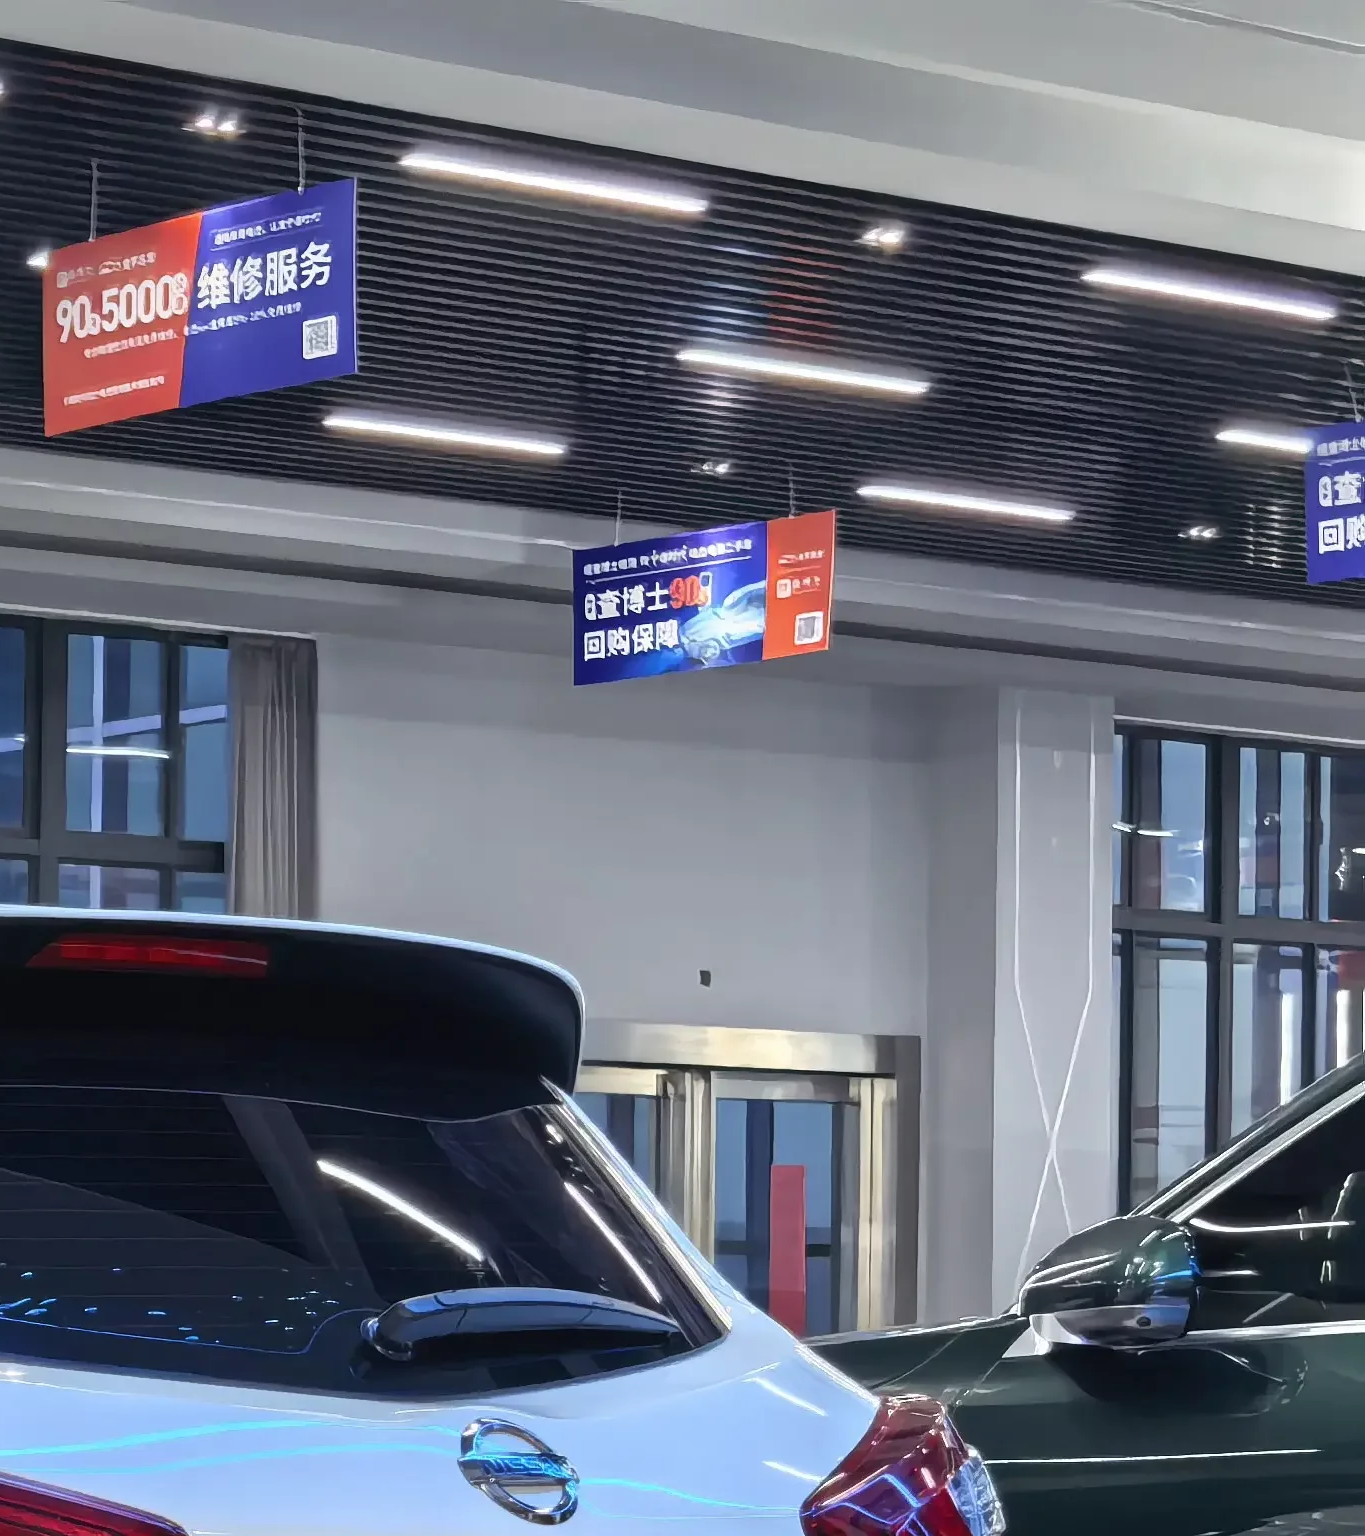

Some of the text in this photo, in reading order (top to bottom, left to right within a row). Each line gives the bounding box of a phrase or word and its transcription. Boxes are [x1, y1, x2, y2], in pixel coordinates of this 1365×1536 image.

[197, 241, 332, 309] 维修服务
[584, 619, 680, 661] 回购保障
